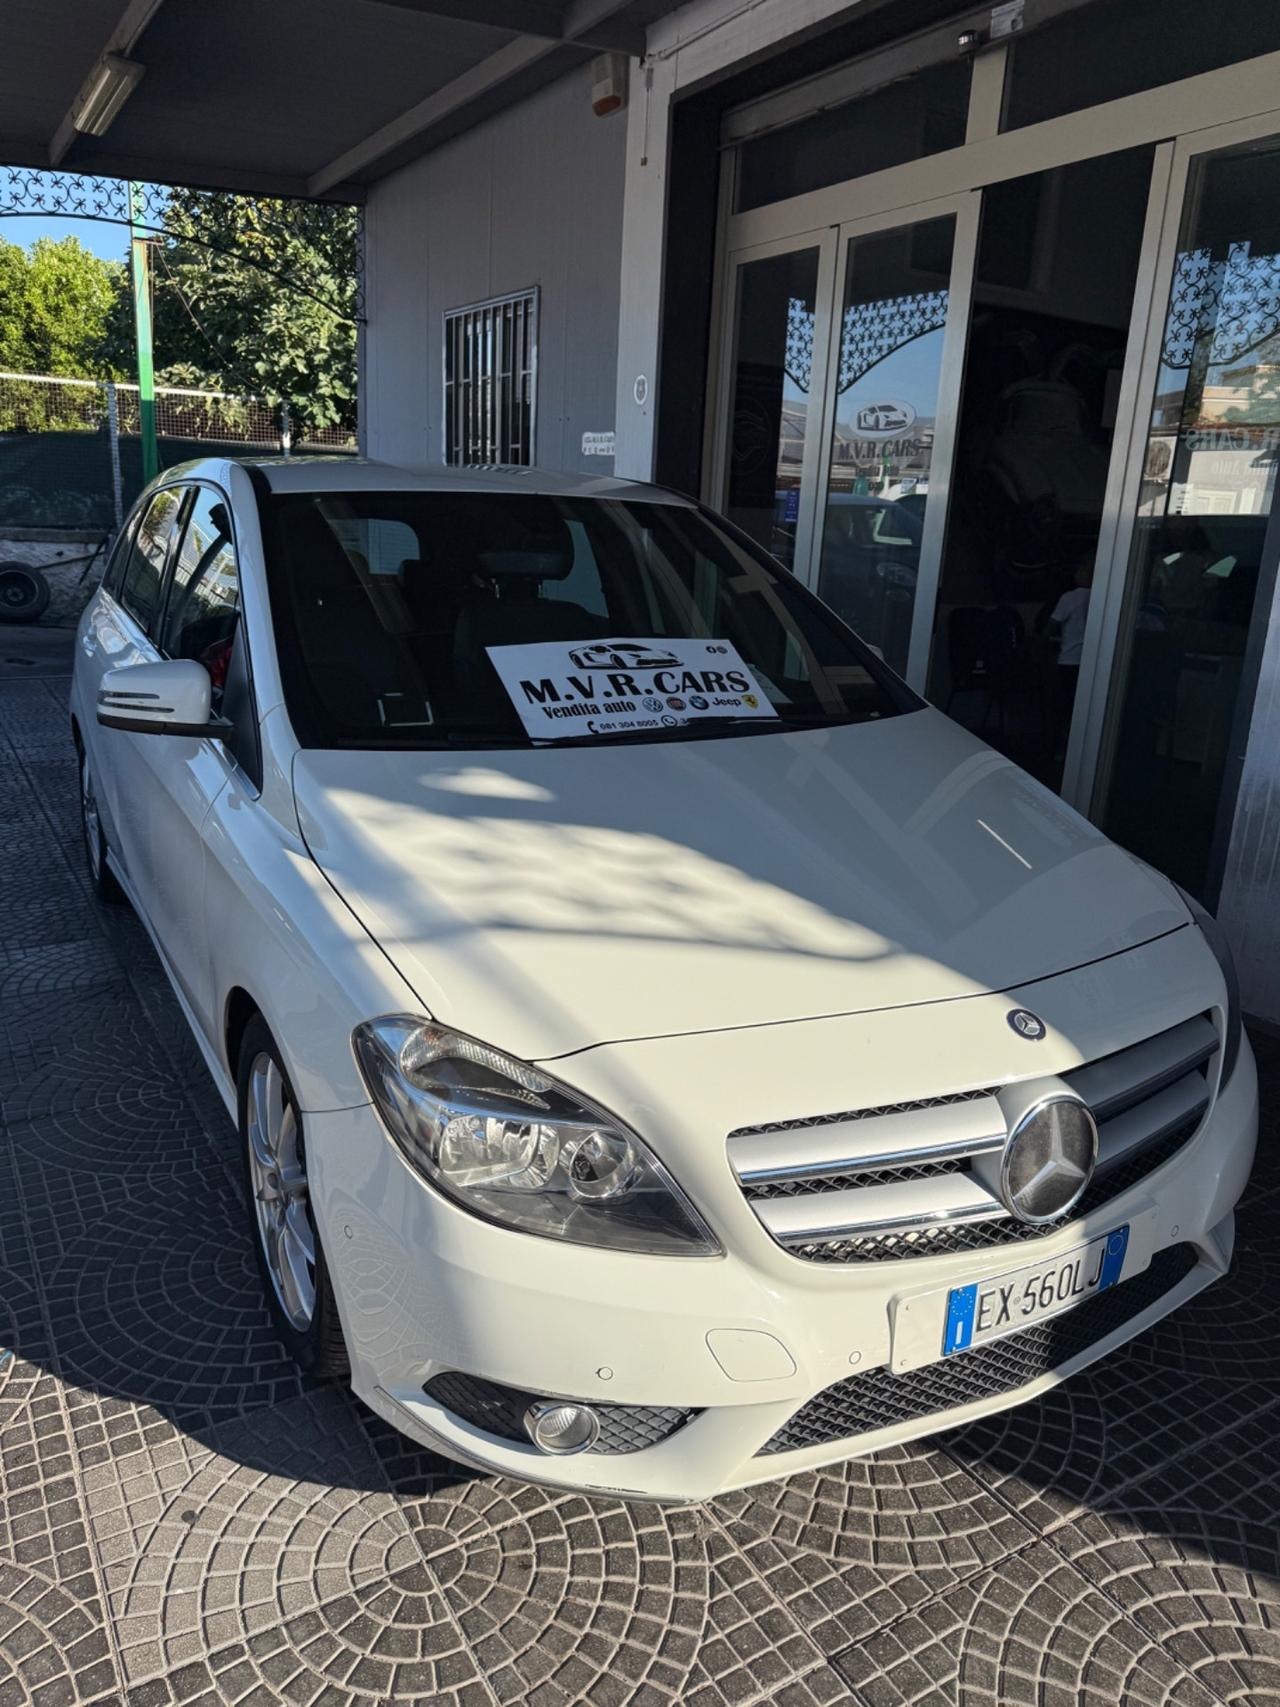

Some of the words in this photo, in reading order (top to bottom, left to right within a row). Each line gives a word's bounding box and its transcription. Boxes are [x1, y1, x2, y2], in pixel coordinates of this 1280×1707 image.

[839, 438, 922, 460] M.V.R.CARS
[519, 670, 750, 705] M.V.R.CARS
[542, 701, 601, 719] Vendita
[604, 699, 637, 714] auto
[712, 697, 742, 708] Jeep
[599, 722, 617, 731] 081
